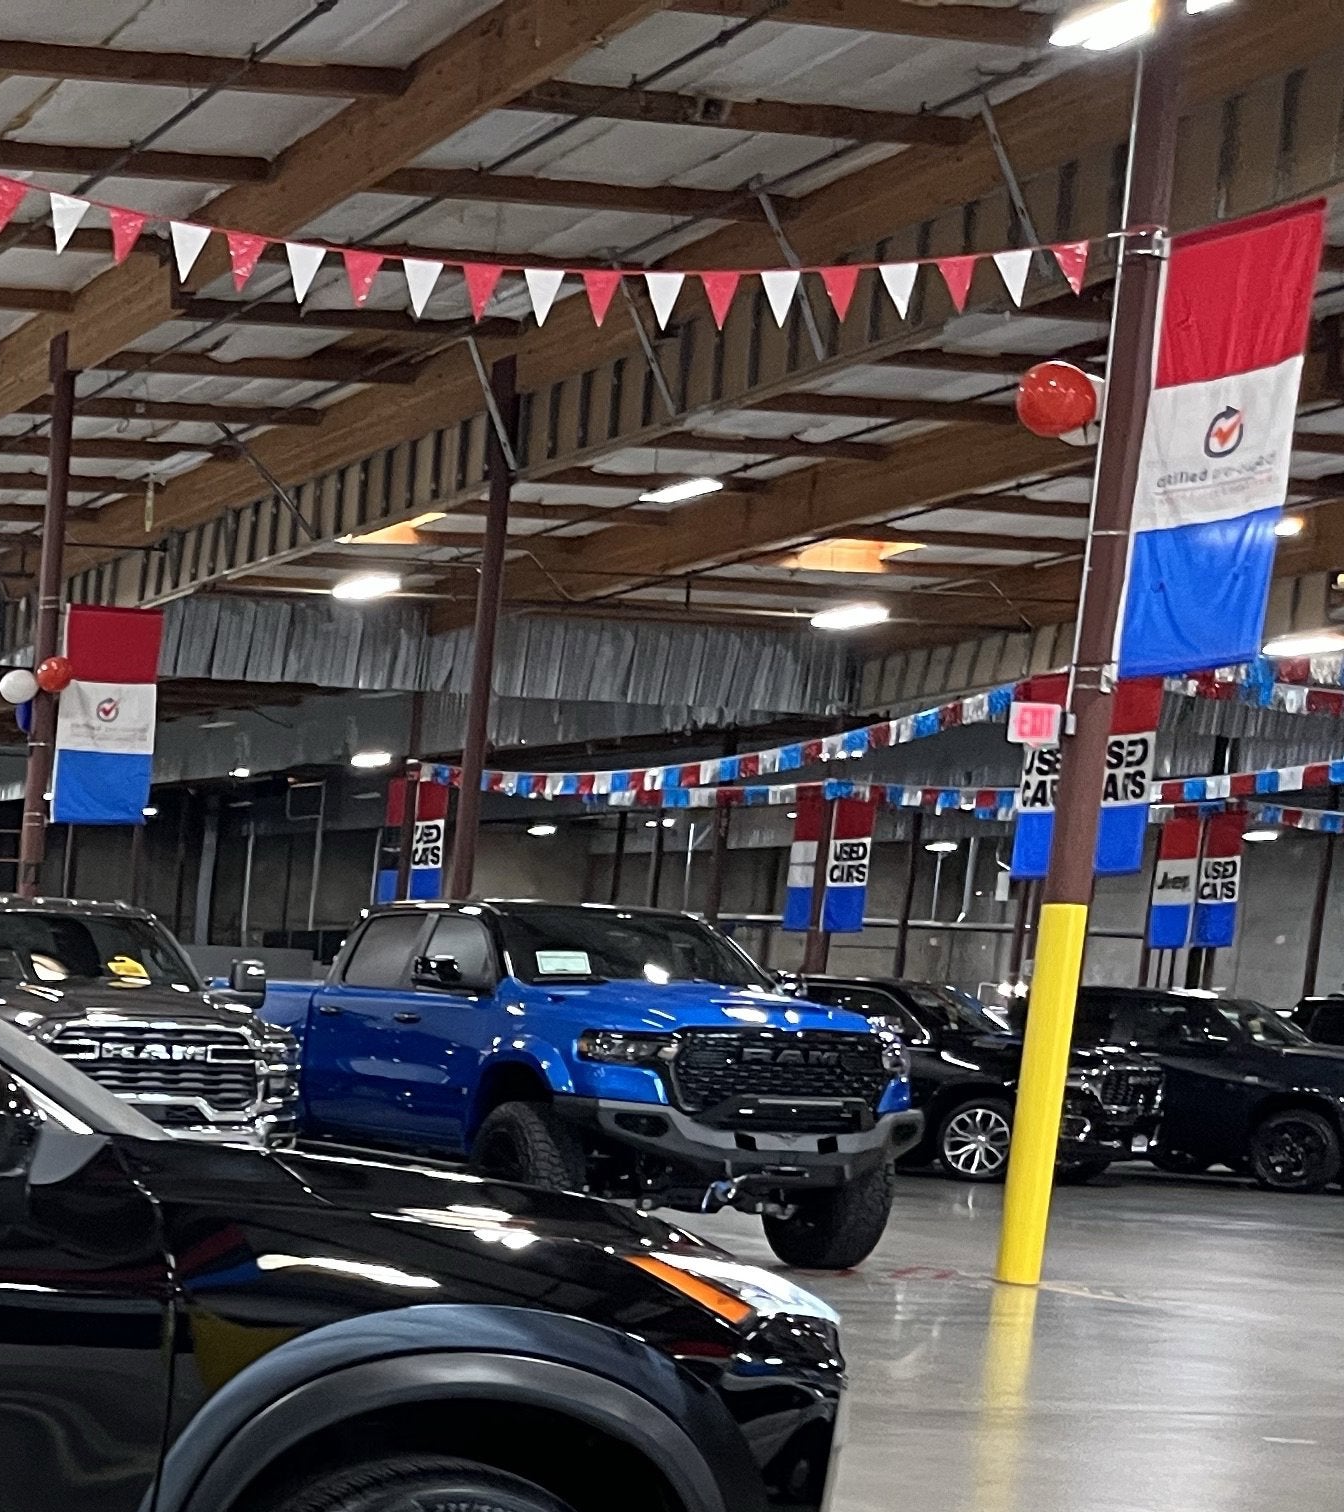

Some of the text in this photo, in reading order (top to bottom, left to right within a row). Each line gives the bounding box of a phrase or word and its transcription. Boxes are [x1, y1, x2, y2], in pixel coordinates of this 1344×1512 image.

[1017, 707, 1055, 737] EXIT
[1106, 738, 1149, 769] SED
[1103, 770, 1146, 801] ARS
[834, 842, 868, 862] USED
[1199, 880, 1237, 900] CAS
[101, 1042, 207, 1061] RAM
[742, 1047, 843, 1067] RAM
